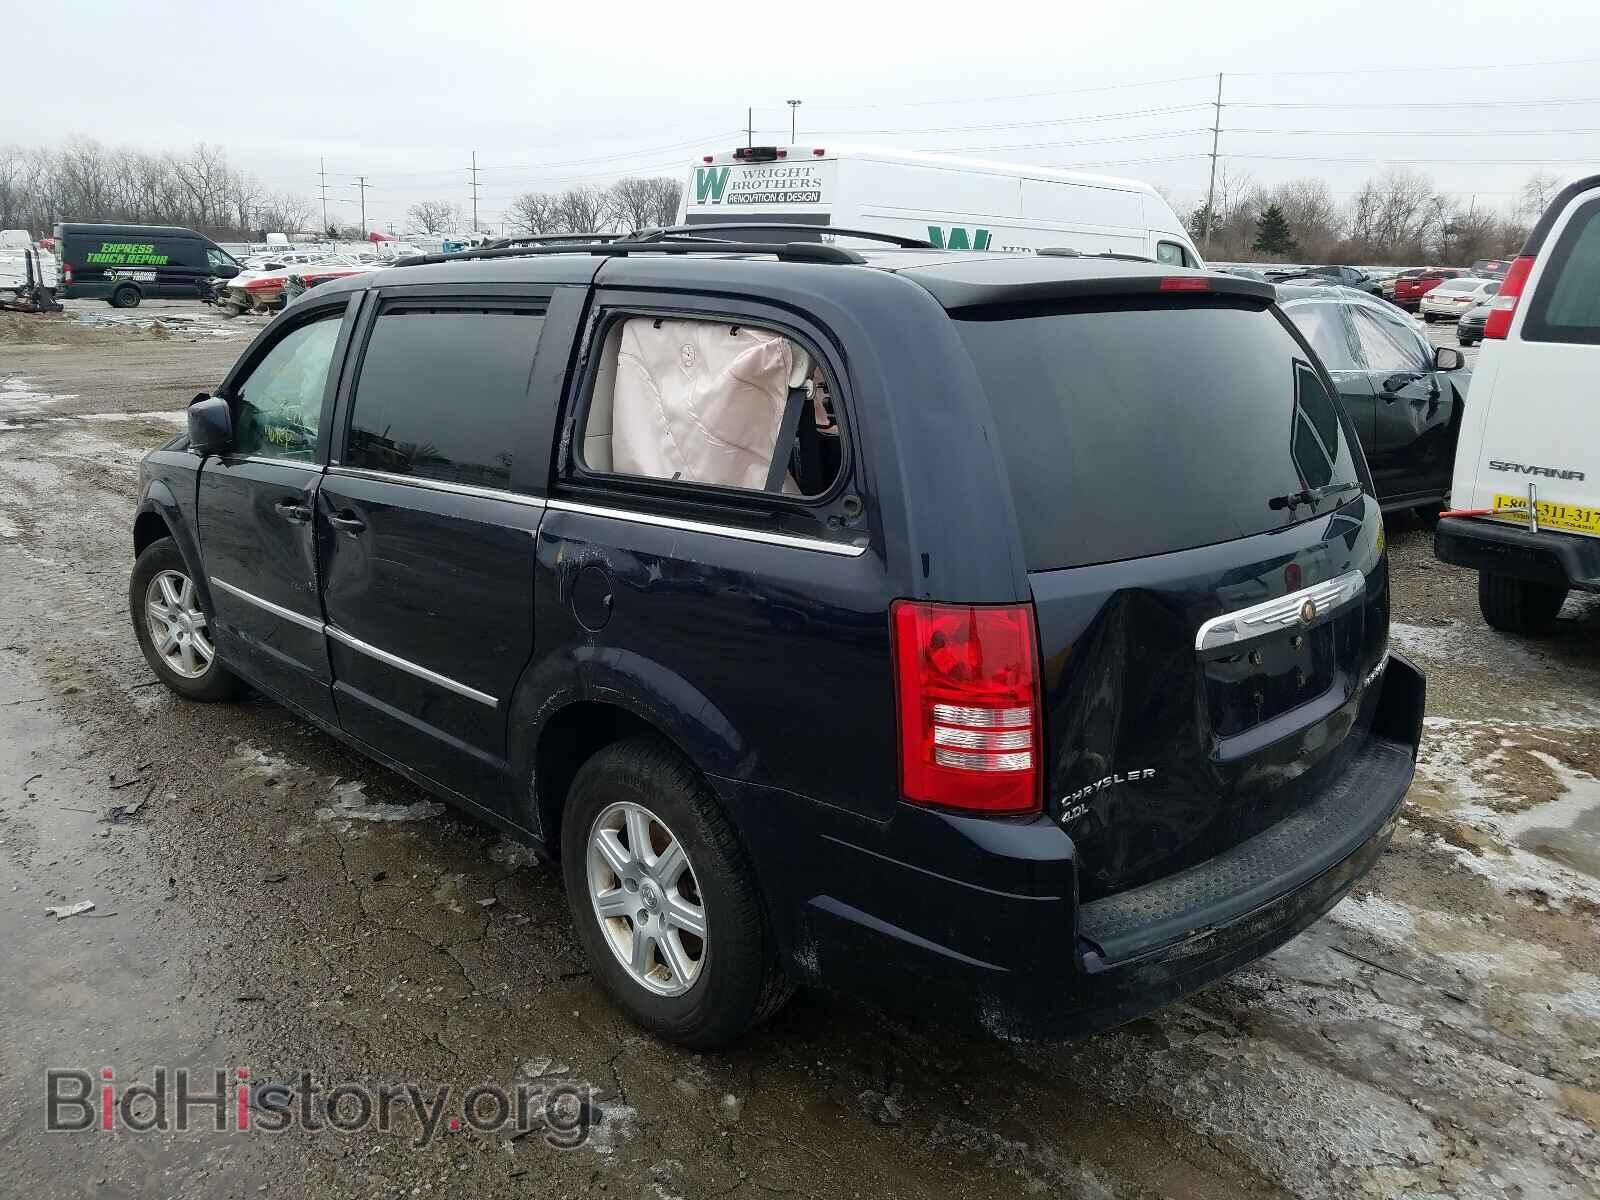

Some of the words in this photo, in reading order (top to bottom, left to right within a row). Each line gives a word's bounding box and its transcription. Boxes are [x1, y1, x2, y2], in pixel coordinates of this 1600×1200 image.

[742, 167, 815, 179] WRIGHT
[696, 168, 730, 204] W
[731, 178, 822, 190] BROTHERS
[729, 193, 776, 203] RENOVATION
[778, 193, 785, 202] &
[787, 191, 818, 202] DESIGN
[101, 243, 154, 254] EXPRESS
[86, 253, 126, 263] TRUCK
[126, 255, 169, 265] REPAIR
[1488, 460, 1585, 481] SAVANA
[1497, 496, 1600, 525] 1-80-311-317
[1061, 768, 1156, 807] CHRYSLER
